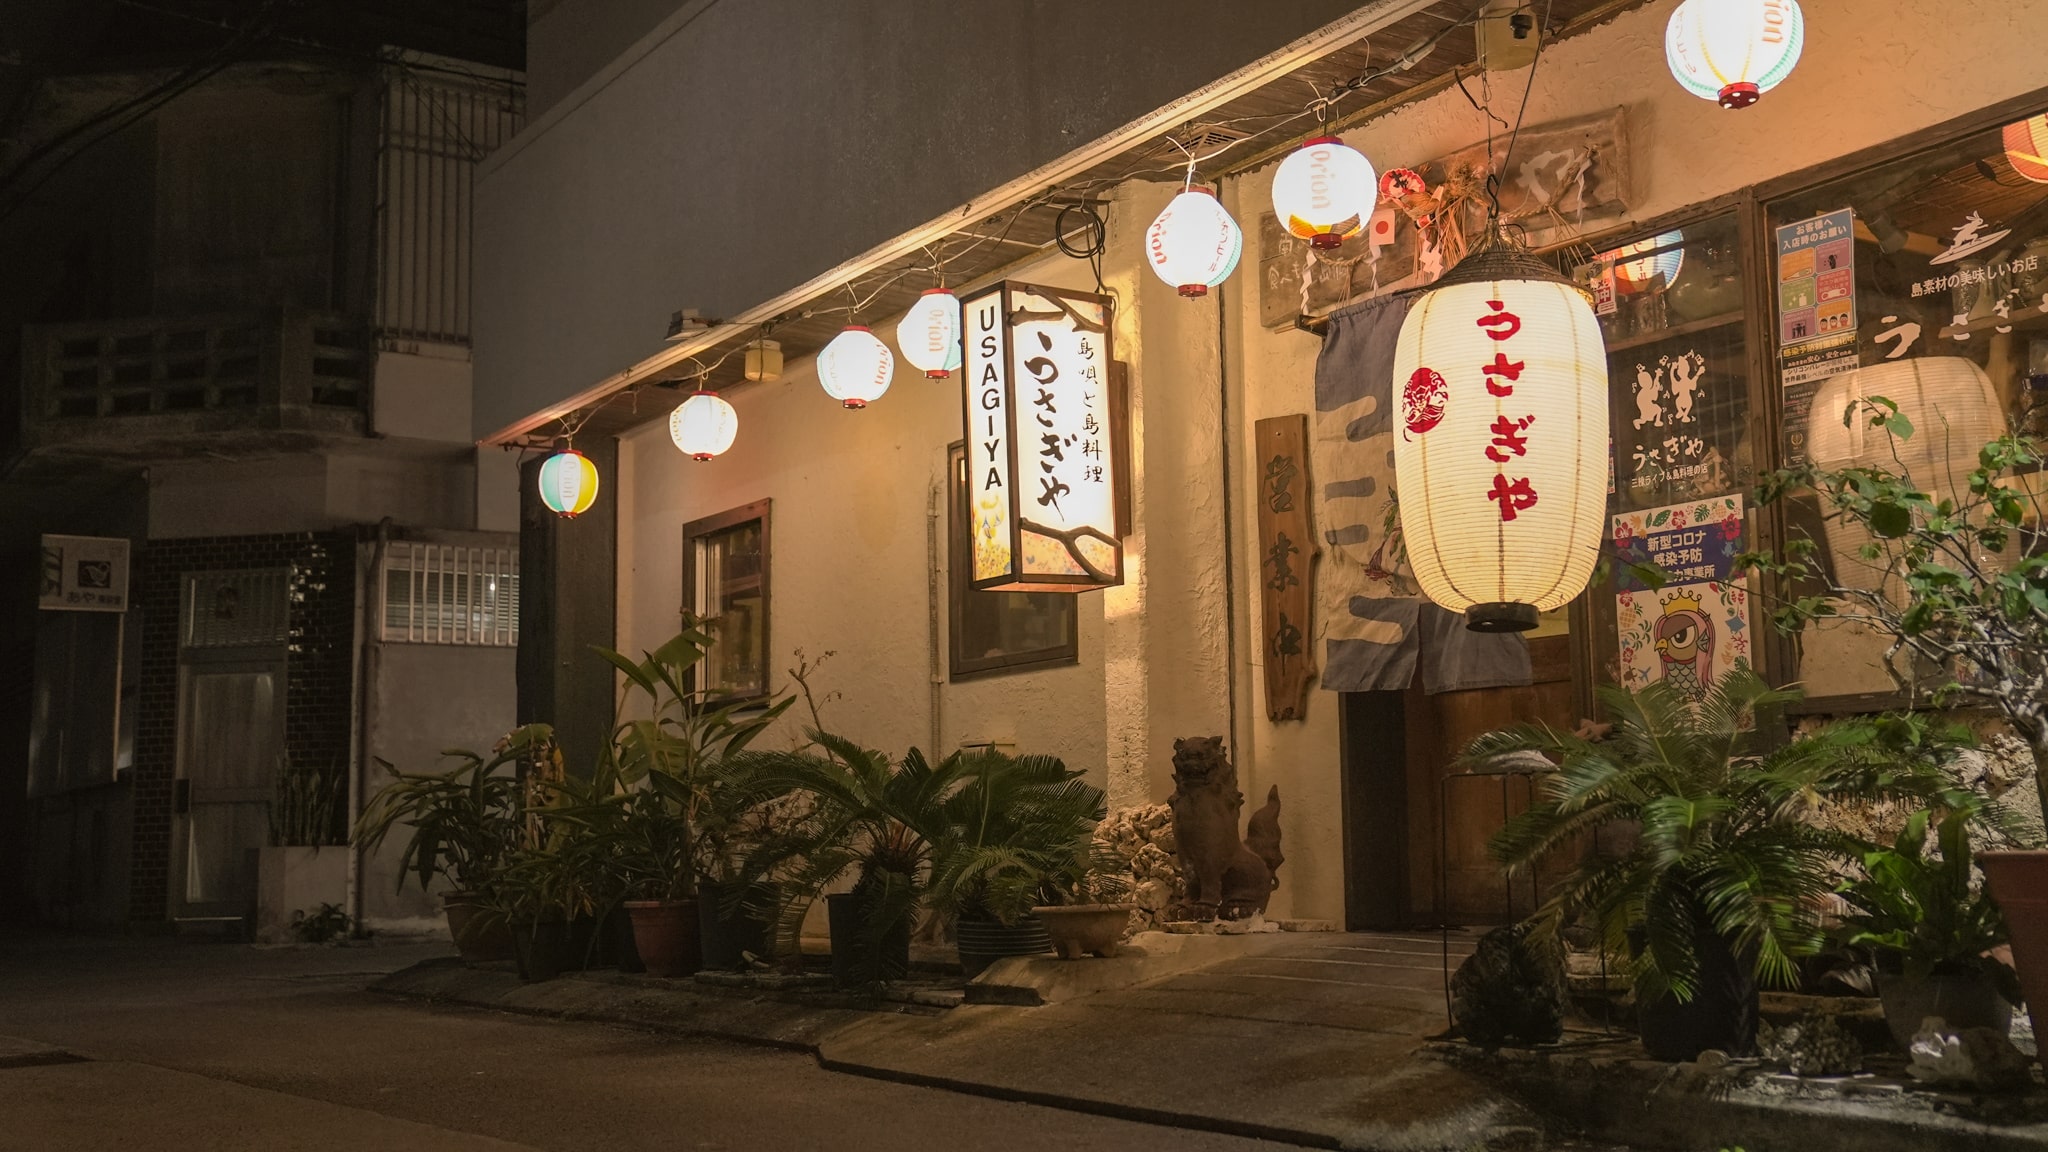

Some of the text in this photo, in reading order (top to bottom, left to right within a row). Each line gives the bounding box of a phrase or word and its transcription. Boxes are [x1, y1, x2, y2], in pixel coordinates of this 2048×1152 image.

[1783, 225, 1847, 250] 入店時のお願い
[1796, 219, 1833, 236] お客様へ
[1911, 255, 2039, 298] 島素材の美味しいお店
[980, 305, 1002, 491] USAGIYA
[1077, 337, 1104, 483] 島唄と島料理
[1476, 300, 1538, 521] うさぎや
[1024, 330, 1077, 522] うさぎや
[1632, 435, 1704, 472] うさぎや
[1647, 530, 1707, 552] 新型コロナ
[1653, 548, 1702, 567] 感染予防
